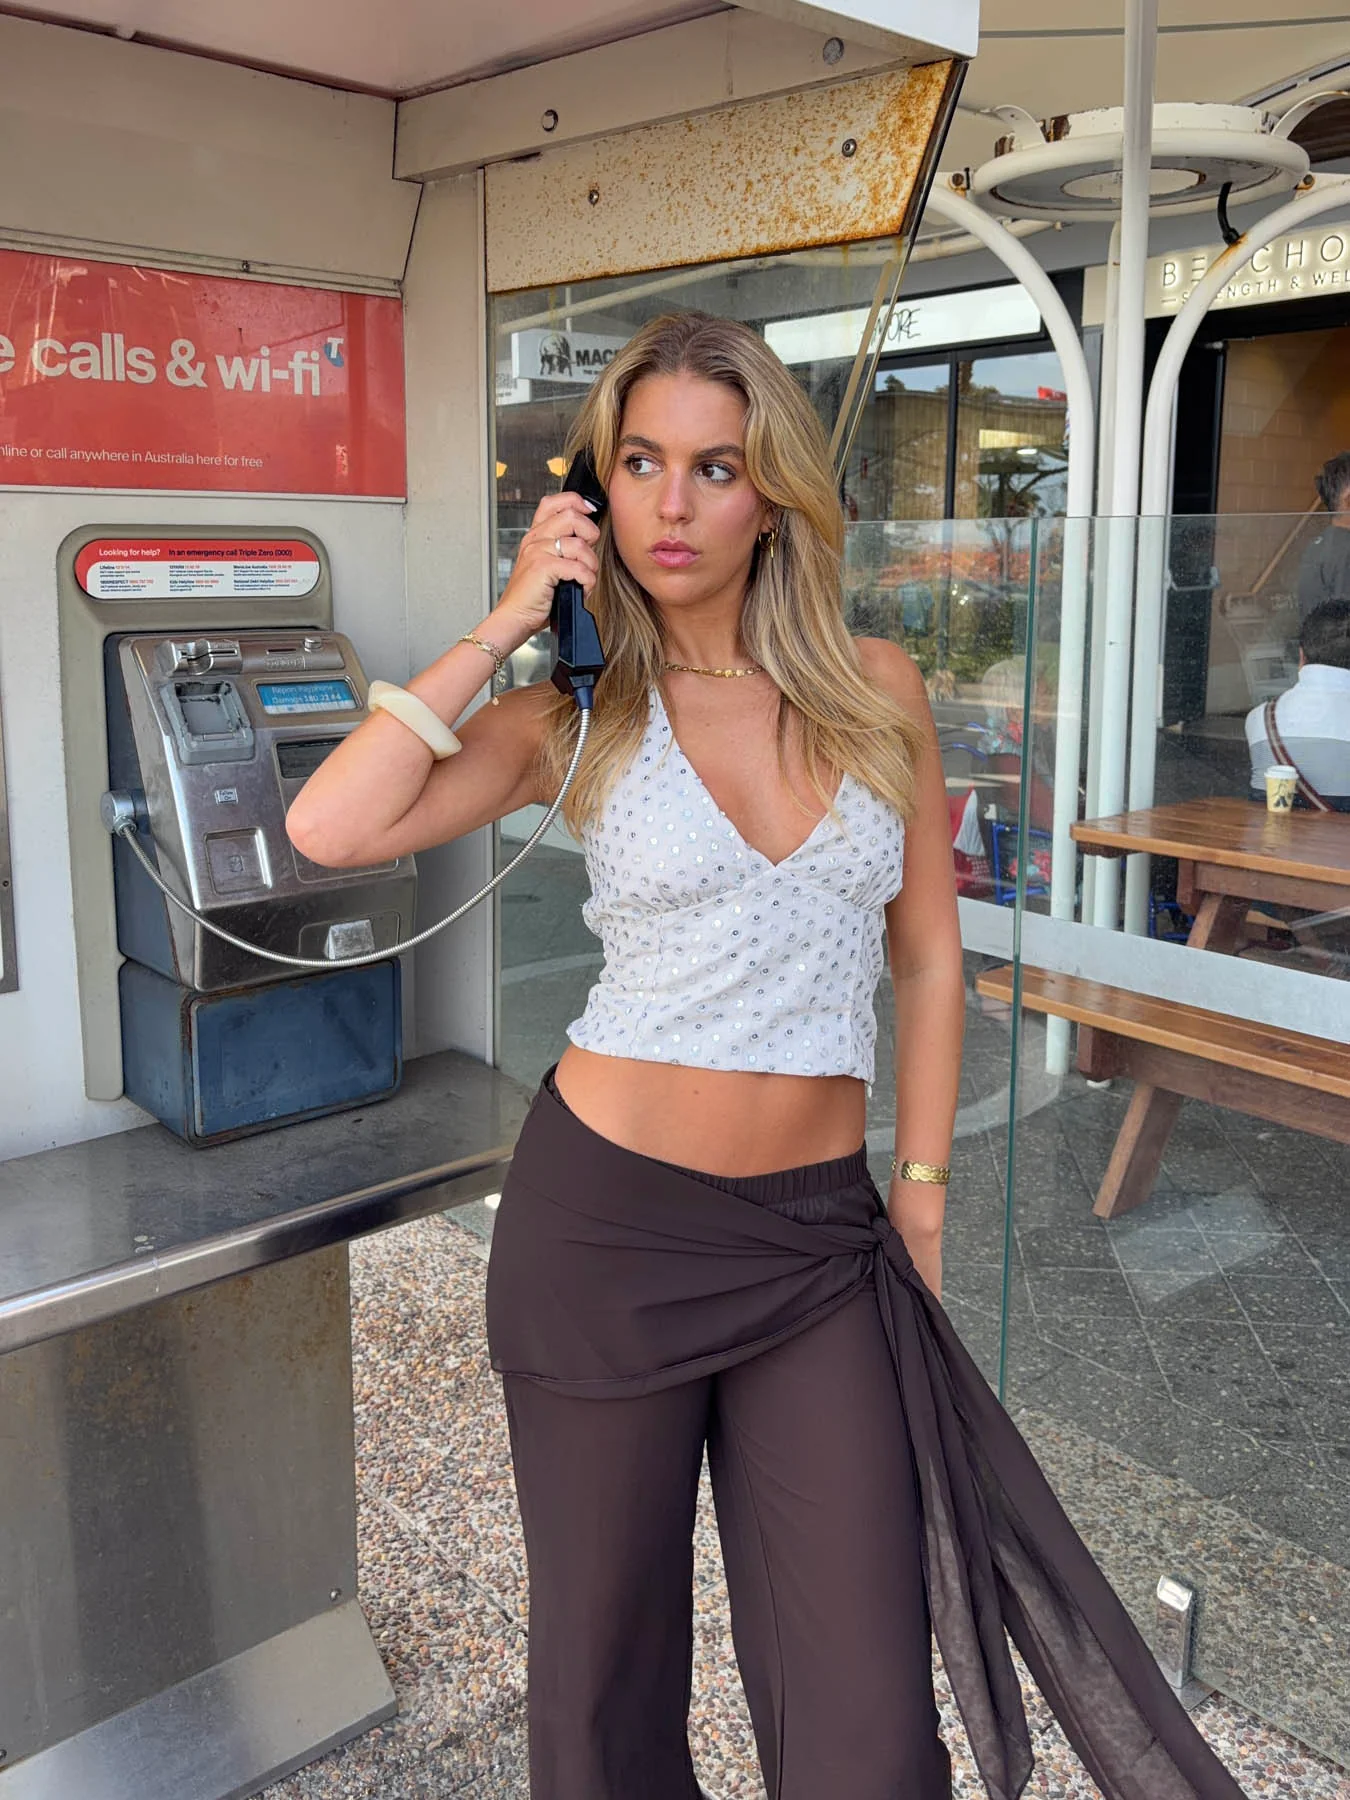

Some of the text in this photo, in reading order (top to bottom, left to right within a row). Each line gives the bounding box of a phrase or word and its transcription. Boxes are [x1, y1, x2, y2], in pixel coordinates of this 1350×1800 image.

[1162, 235, 1344, 287] BECHO
[1290, 275, 1301, 289] &
[31, 332, 157, 384] calls
[166, 338, 208, 388] &
[215, 345, 320, 396] wi-fi
[575, 348, 620, 367] MAC
[30, 447, 43, 458] or
[46, 447, 67, 459] call
[70, 449, 129, 463] anywhere
[132, 450, 142, 462] in
[144, 451, 194, 465] Australia
[196, 454, 222, 466] here
[224, 455, 239, 467] for
[241, 455, 263, 468] free
[99, 548, 129, 558] Looking
[129, 548, 140, 556] for
[141, 548, 161, 557] help?
[239, 549, 257, 557] Triple
[274, 549, 292, 557] (000)
